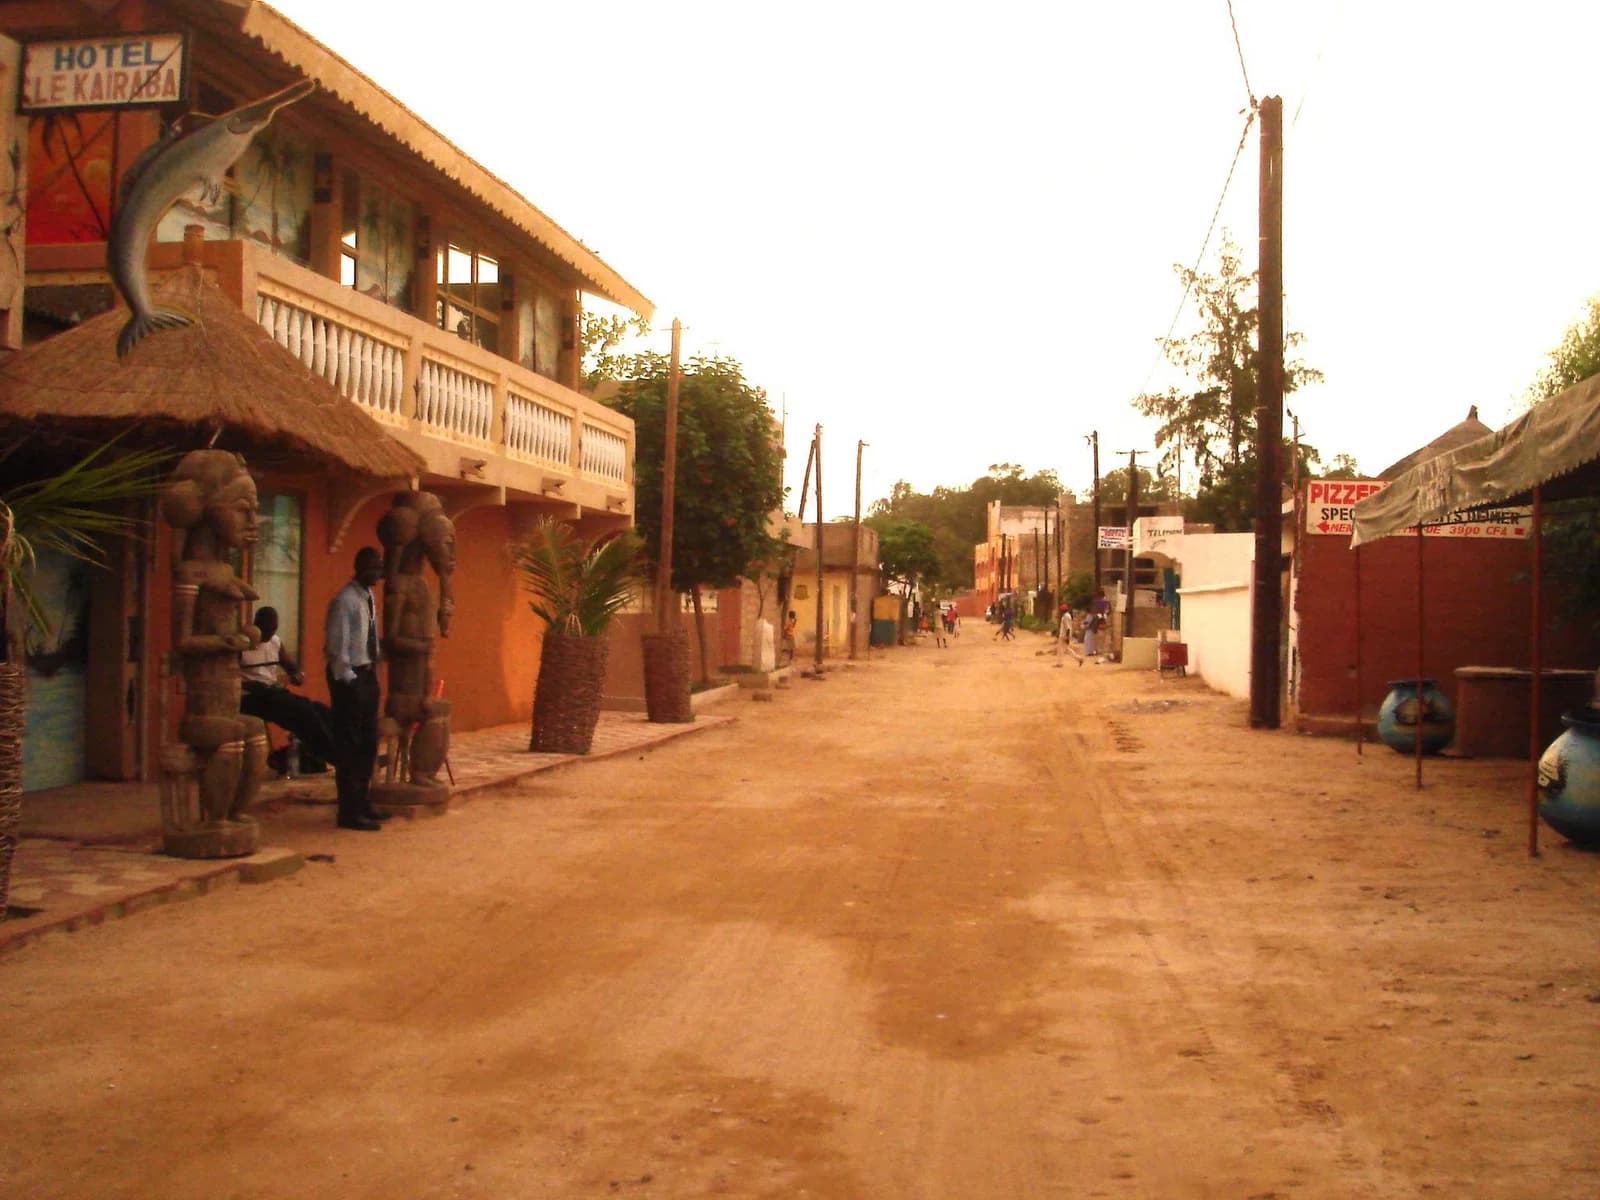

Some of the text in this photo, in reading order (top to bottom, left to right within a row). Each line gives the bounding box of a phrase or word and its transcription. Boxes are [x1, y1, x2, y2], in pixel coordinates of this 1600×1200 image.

[54, 41, 164, 70] HOTEL
[34, 68, 176, 103] LE KAIRABA
